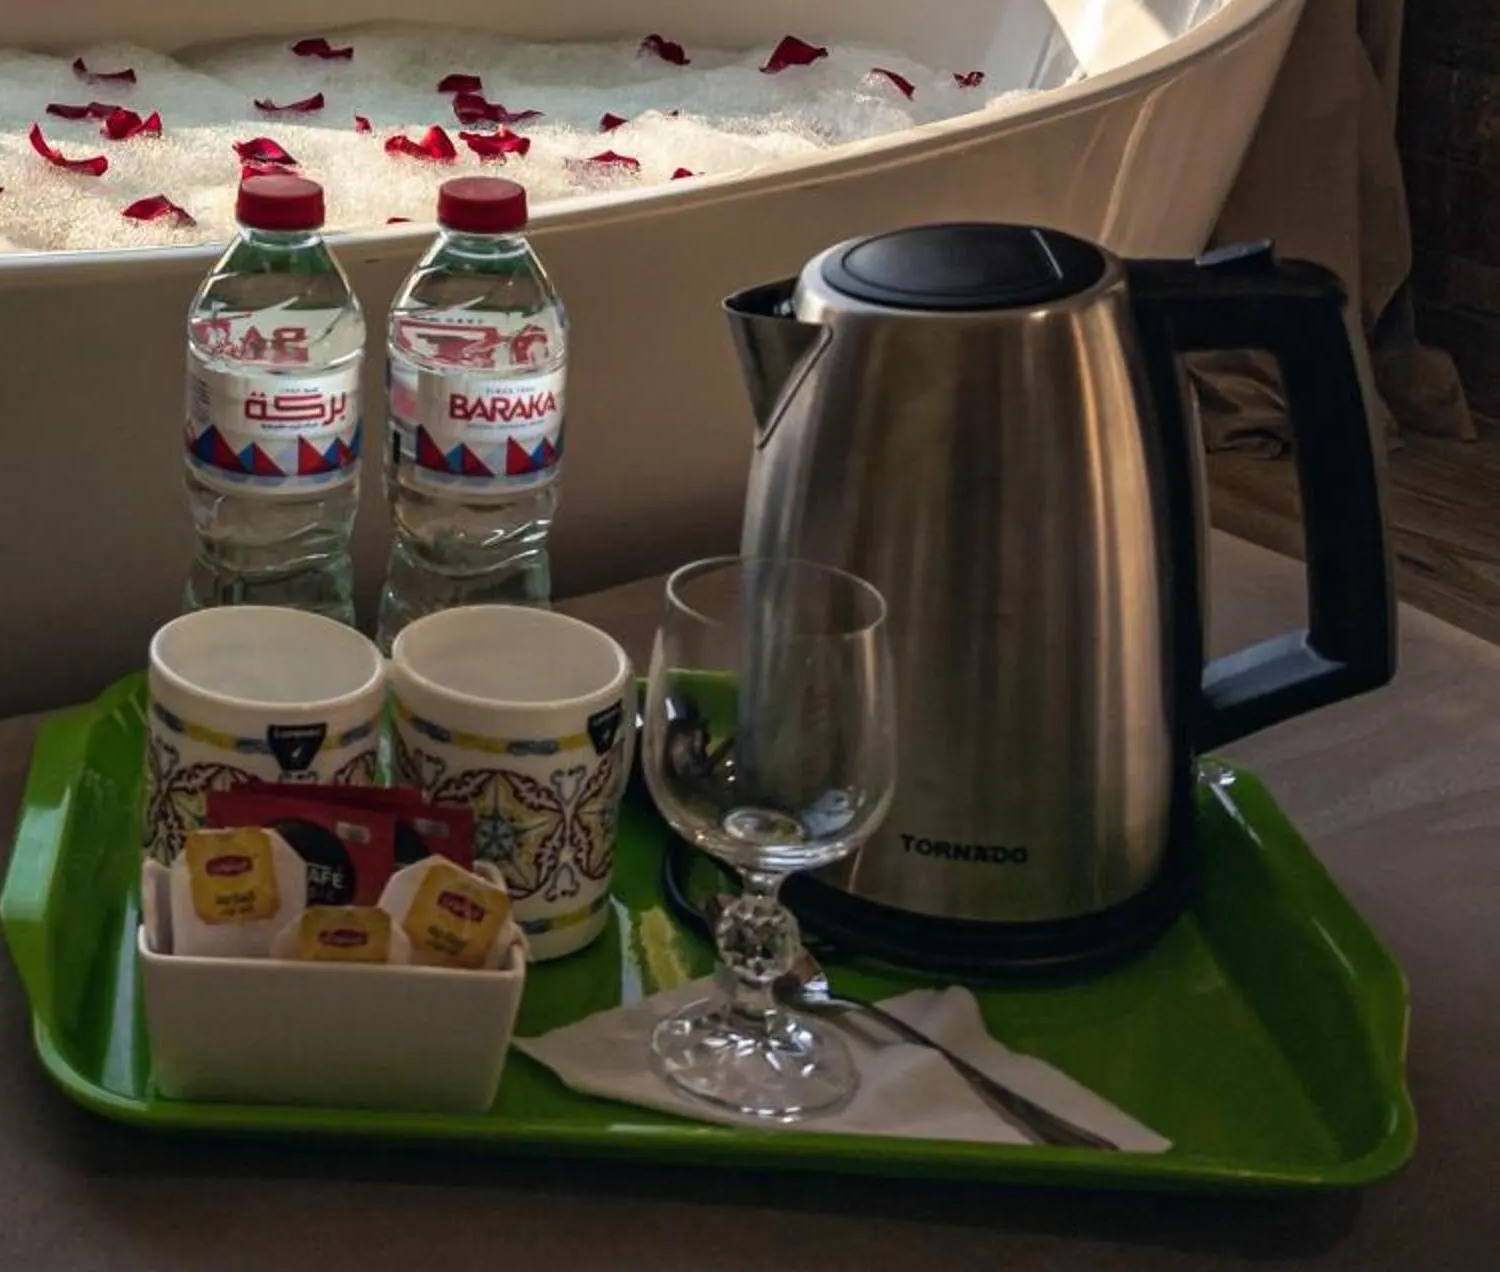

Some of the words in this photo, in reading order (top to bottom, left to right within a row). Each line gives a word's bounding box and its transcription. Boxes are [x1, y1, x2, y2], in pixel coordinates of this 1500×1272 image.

[244, 391, 347, 427] بركة
[449, 390, 556, 423] BARAKA
[900, 833, 1028, 864] TORNADO
